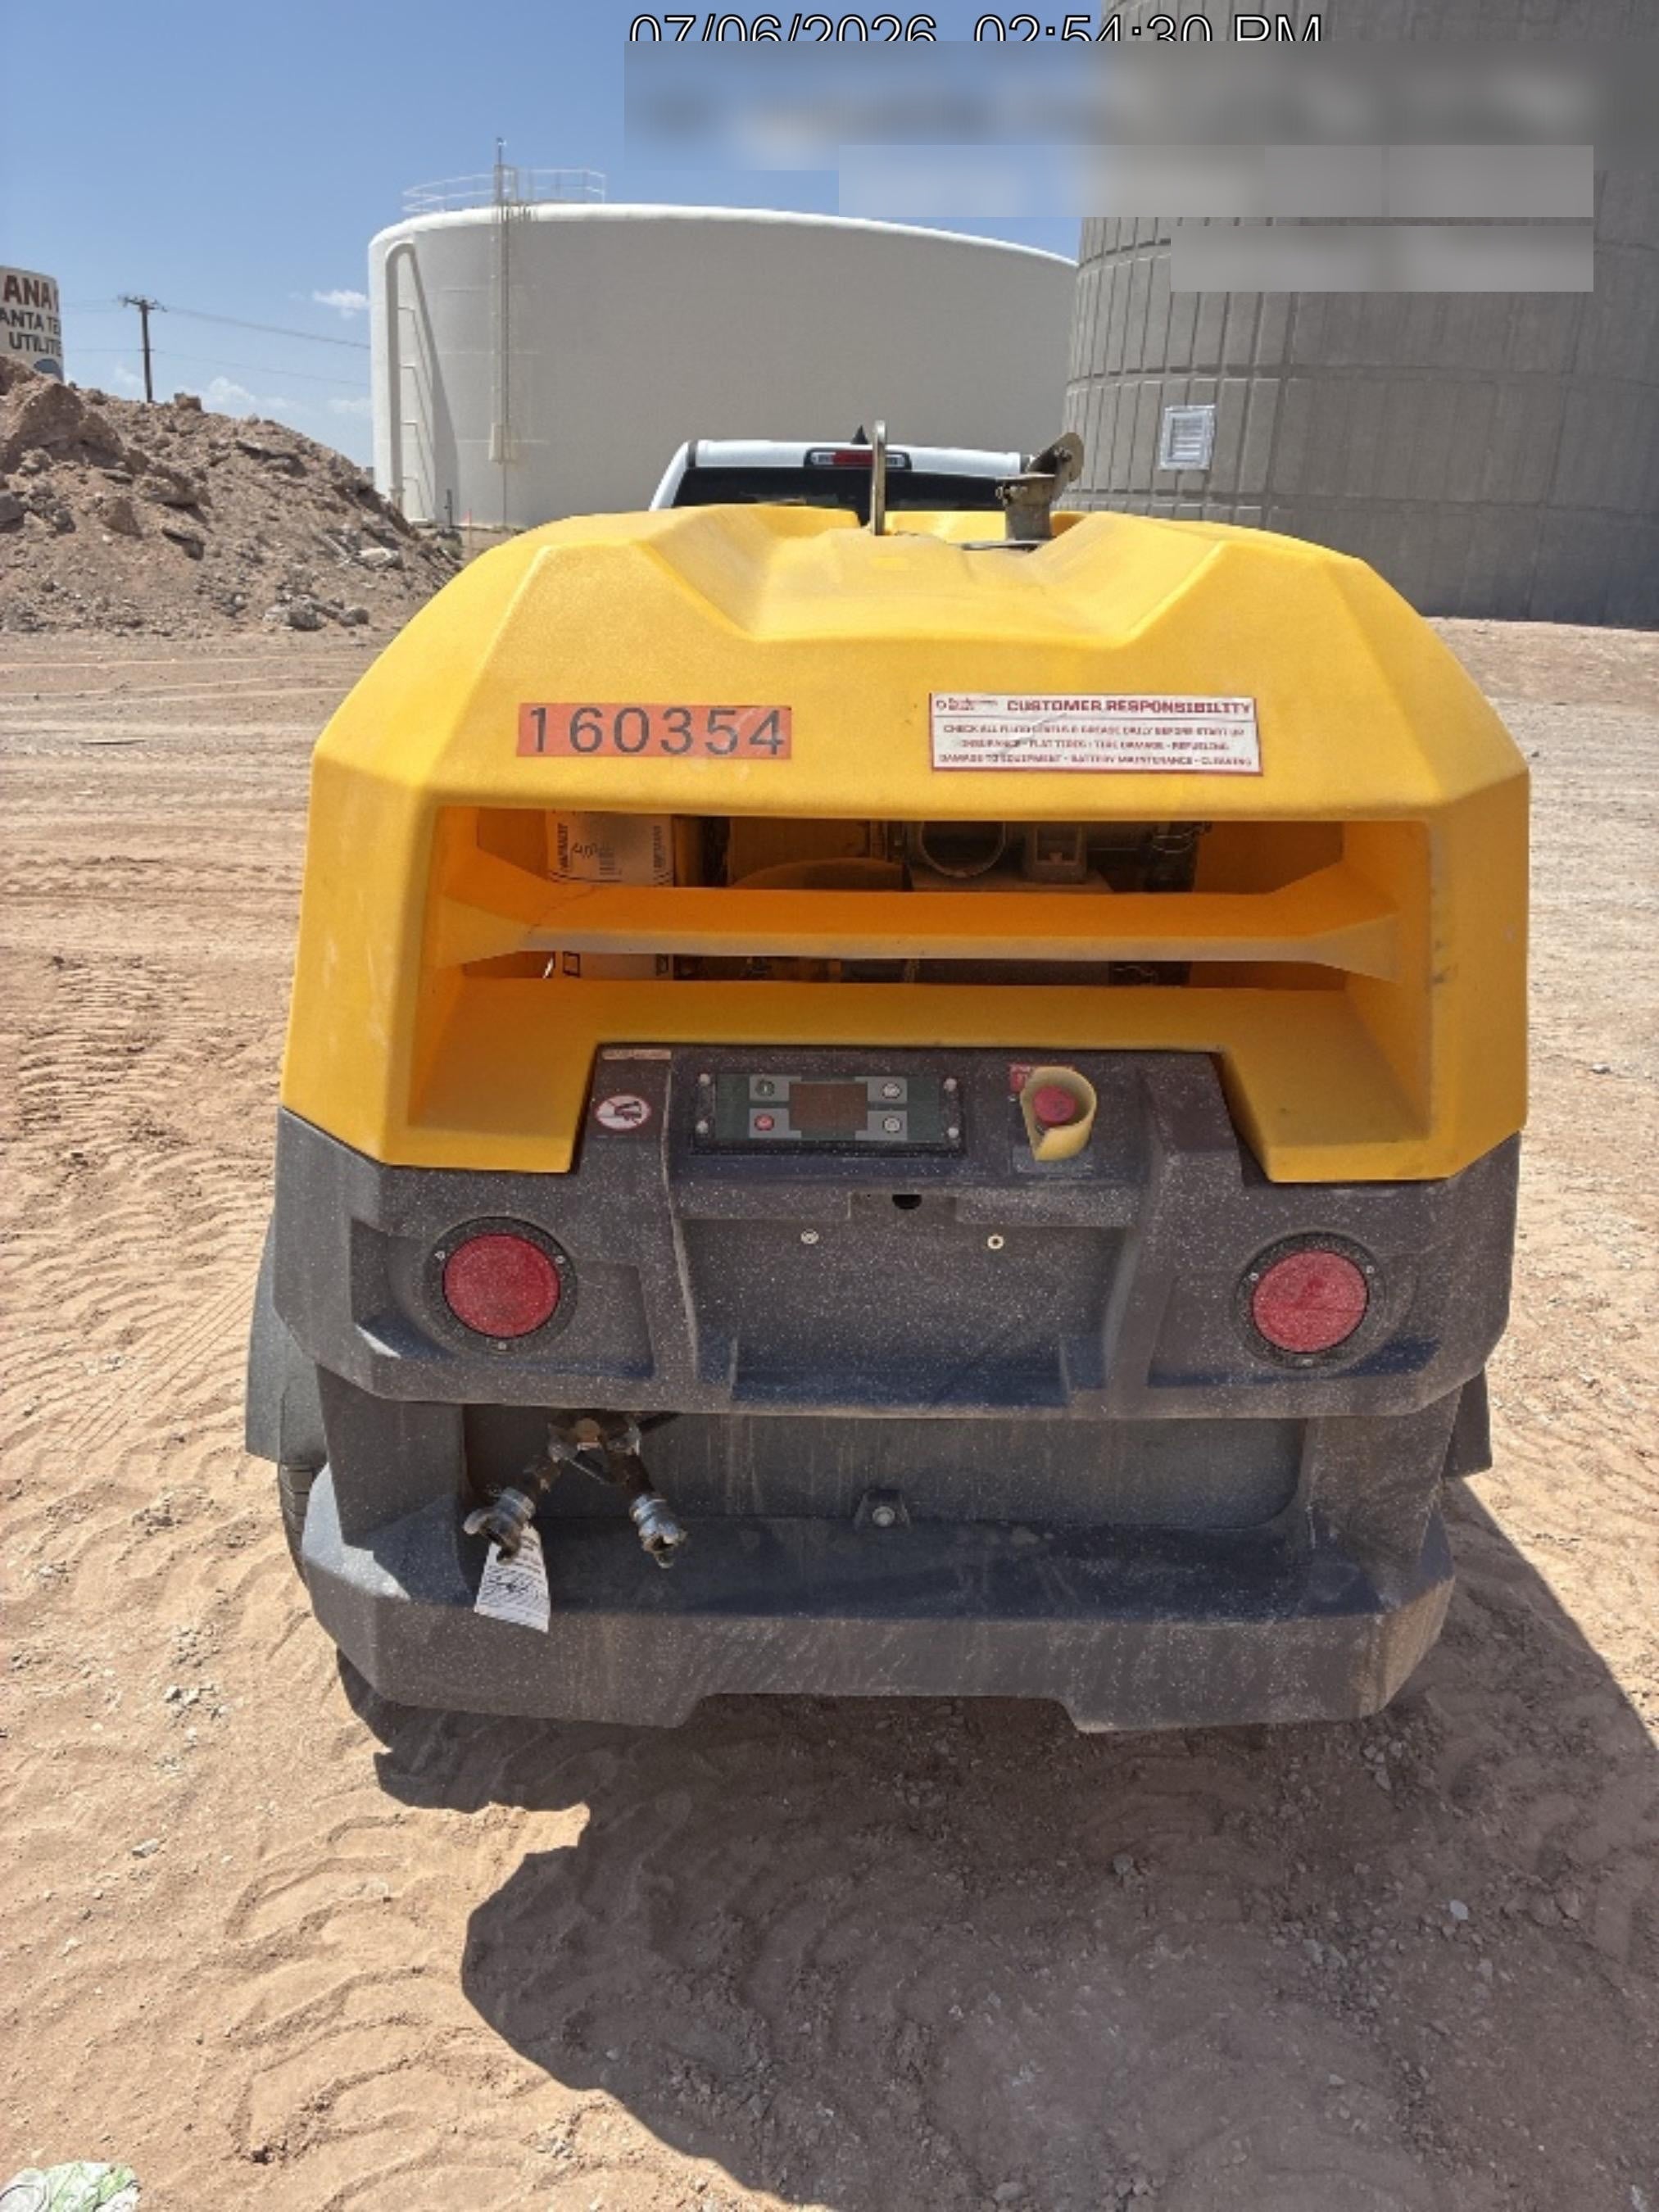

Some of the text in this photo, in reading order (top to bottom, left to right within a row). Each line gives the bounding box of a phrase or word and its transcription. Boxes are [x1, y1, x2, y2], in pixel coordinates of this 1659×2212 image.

[1007, 699, 1102, 712] CUSTOMER
[1106, 700, 1252, 714] RESPONSIBILITY
[530, 707, 784, 755] 160354
